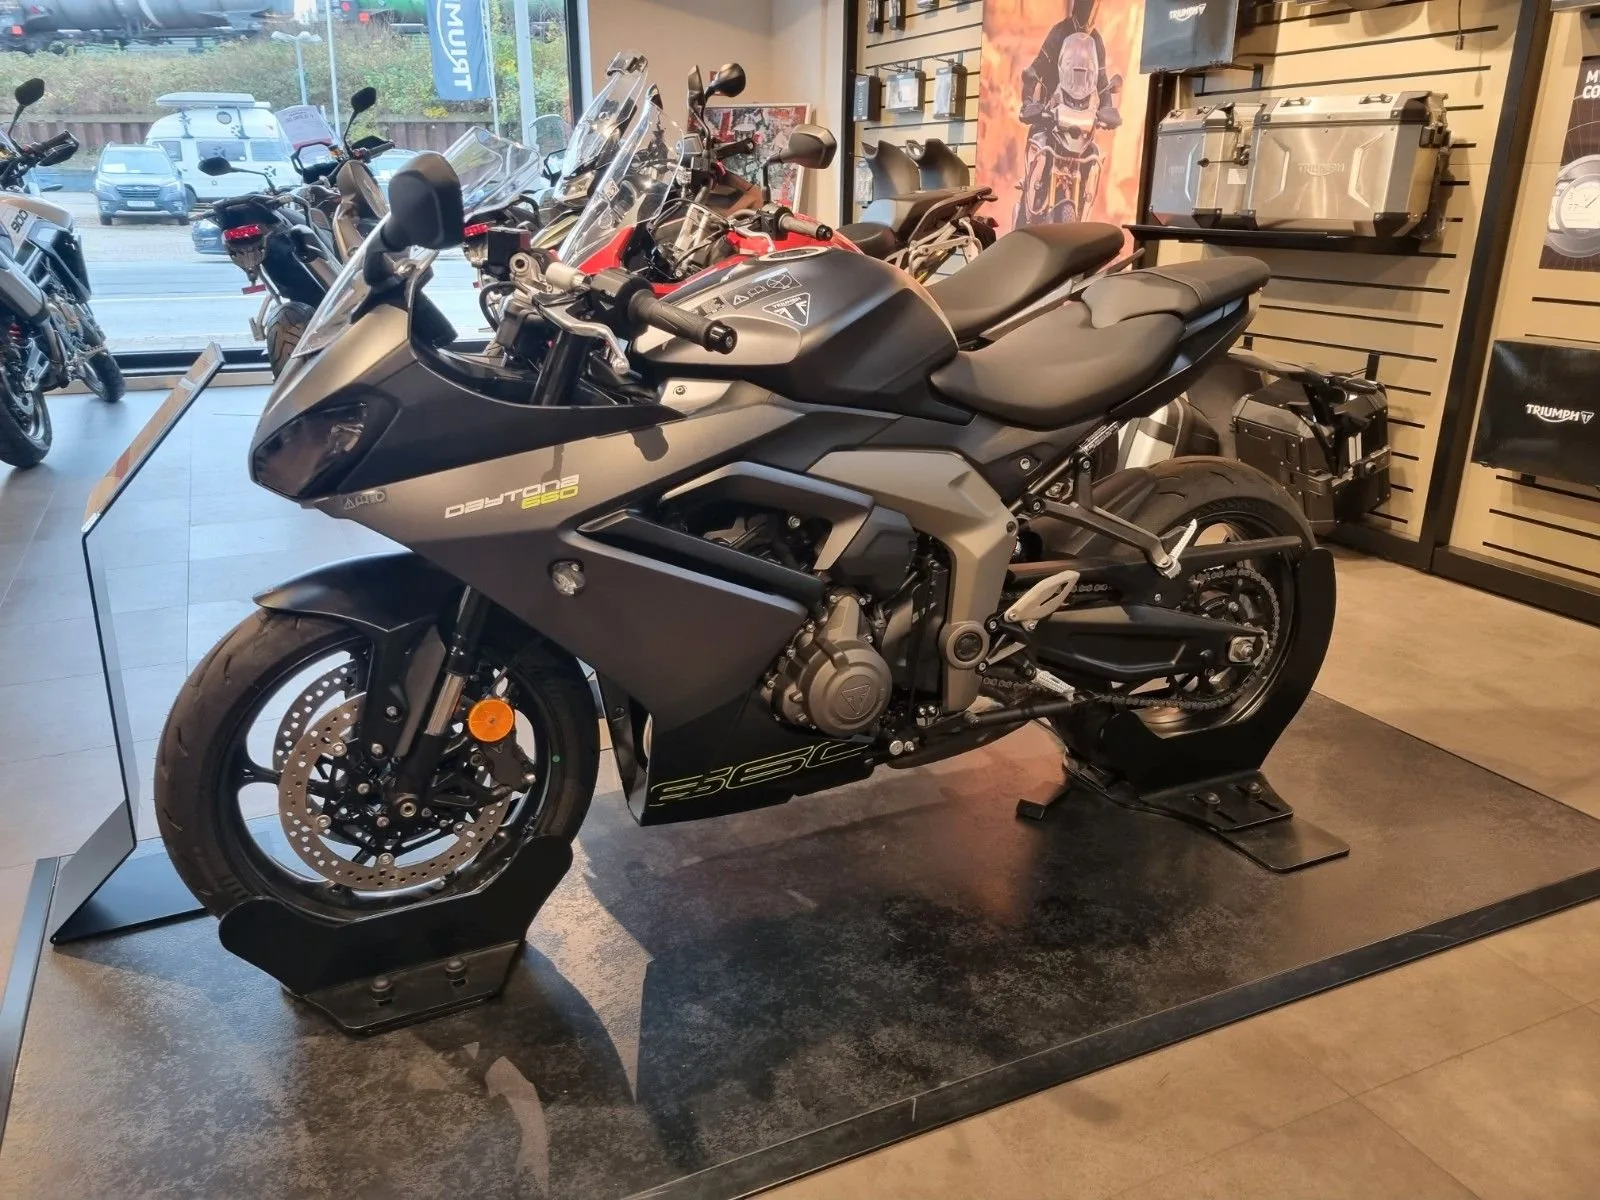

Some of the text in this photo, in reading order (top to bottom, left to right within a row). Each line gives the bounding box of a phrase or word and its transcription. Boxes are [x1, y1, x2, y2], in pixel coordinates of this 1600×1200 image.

[1586, 70, 1600, 84] M
[1297, 162, 1345, 177] TRIUMPH
[11, 209, 29, 234] 900
[1525, 403, 1580, 423] TRIUMPH
[521, 485, 579, 510] 660
